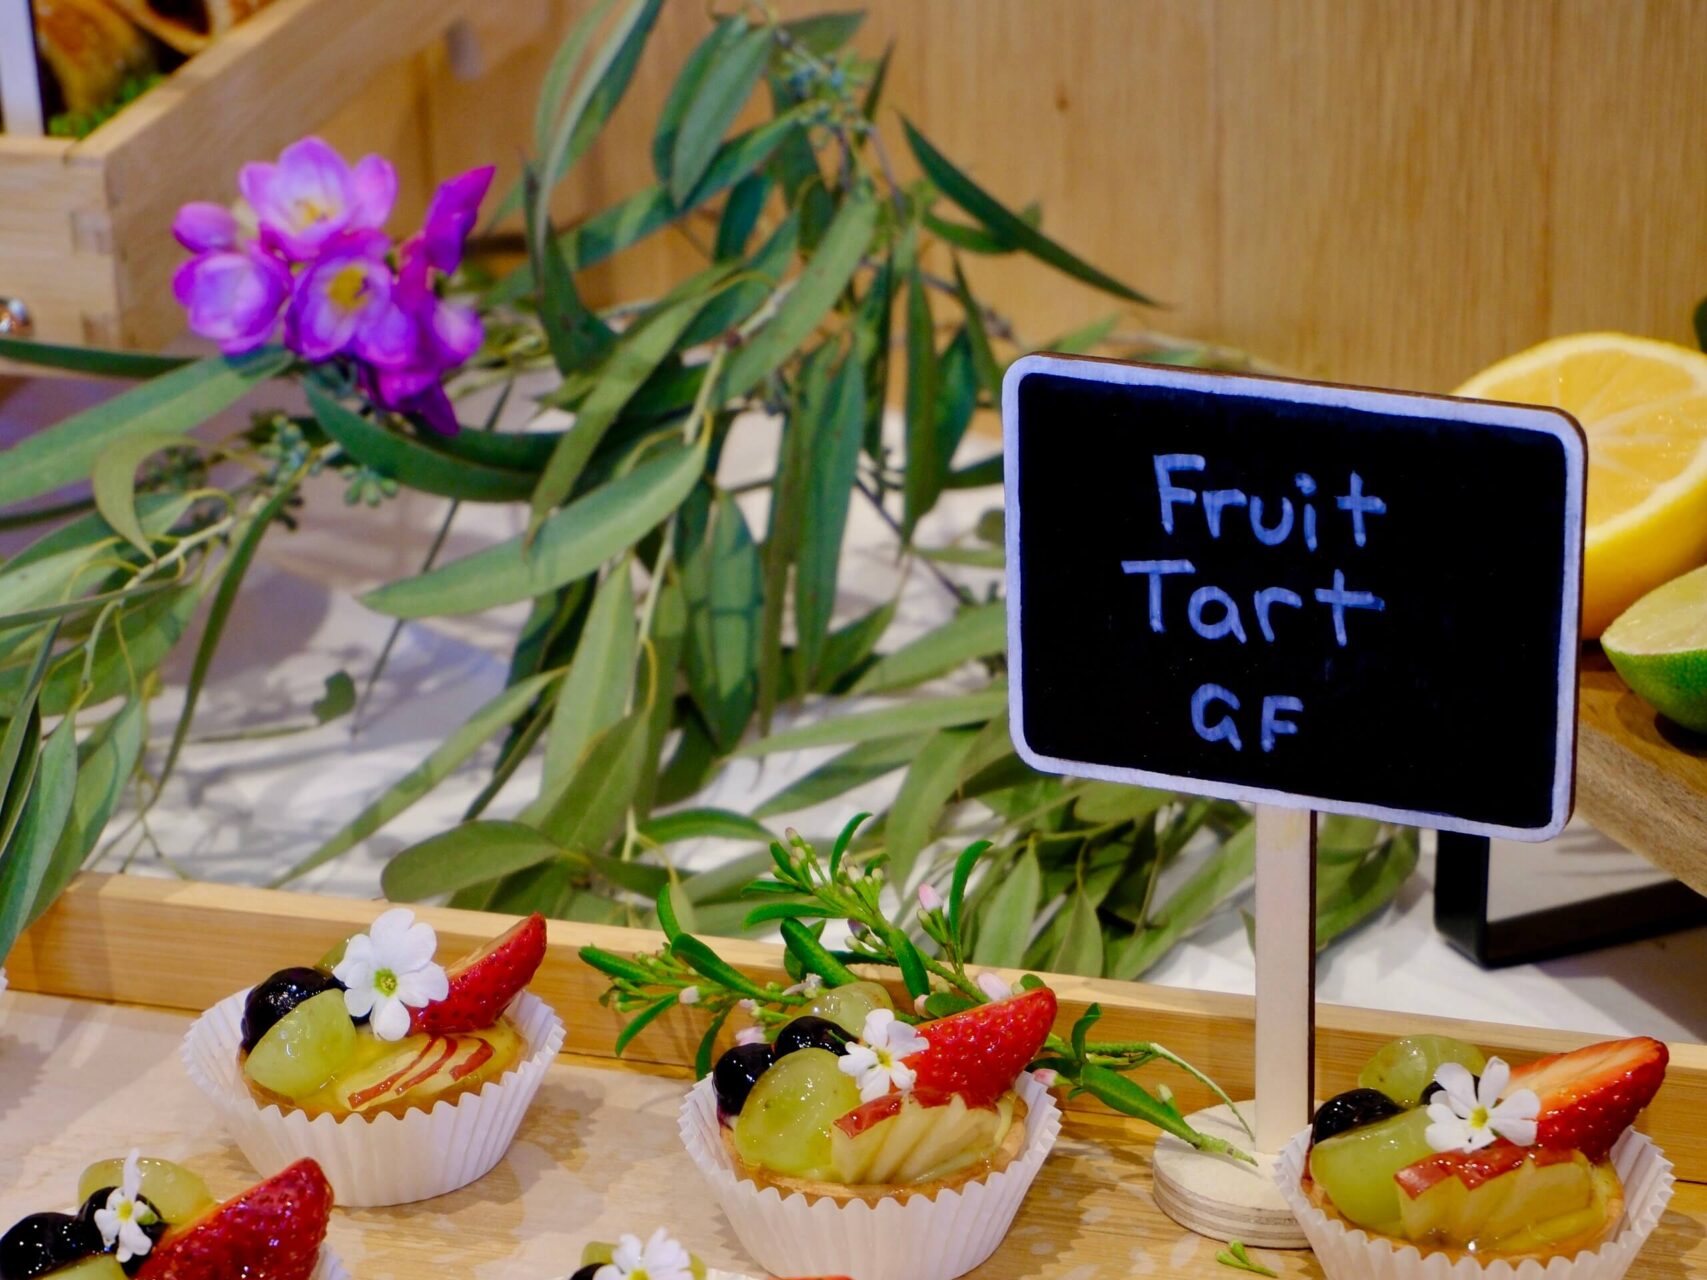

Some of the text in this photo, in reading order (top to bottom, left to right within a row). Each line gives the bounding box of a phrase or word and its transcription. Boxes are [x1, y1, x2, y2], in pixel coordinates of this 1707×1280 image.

[1153, 453, 1387, 551] Fruit
[1120, 559, 1385, 647] Tart
[1190, 682, 1304, 753] GF
